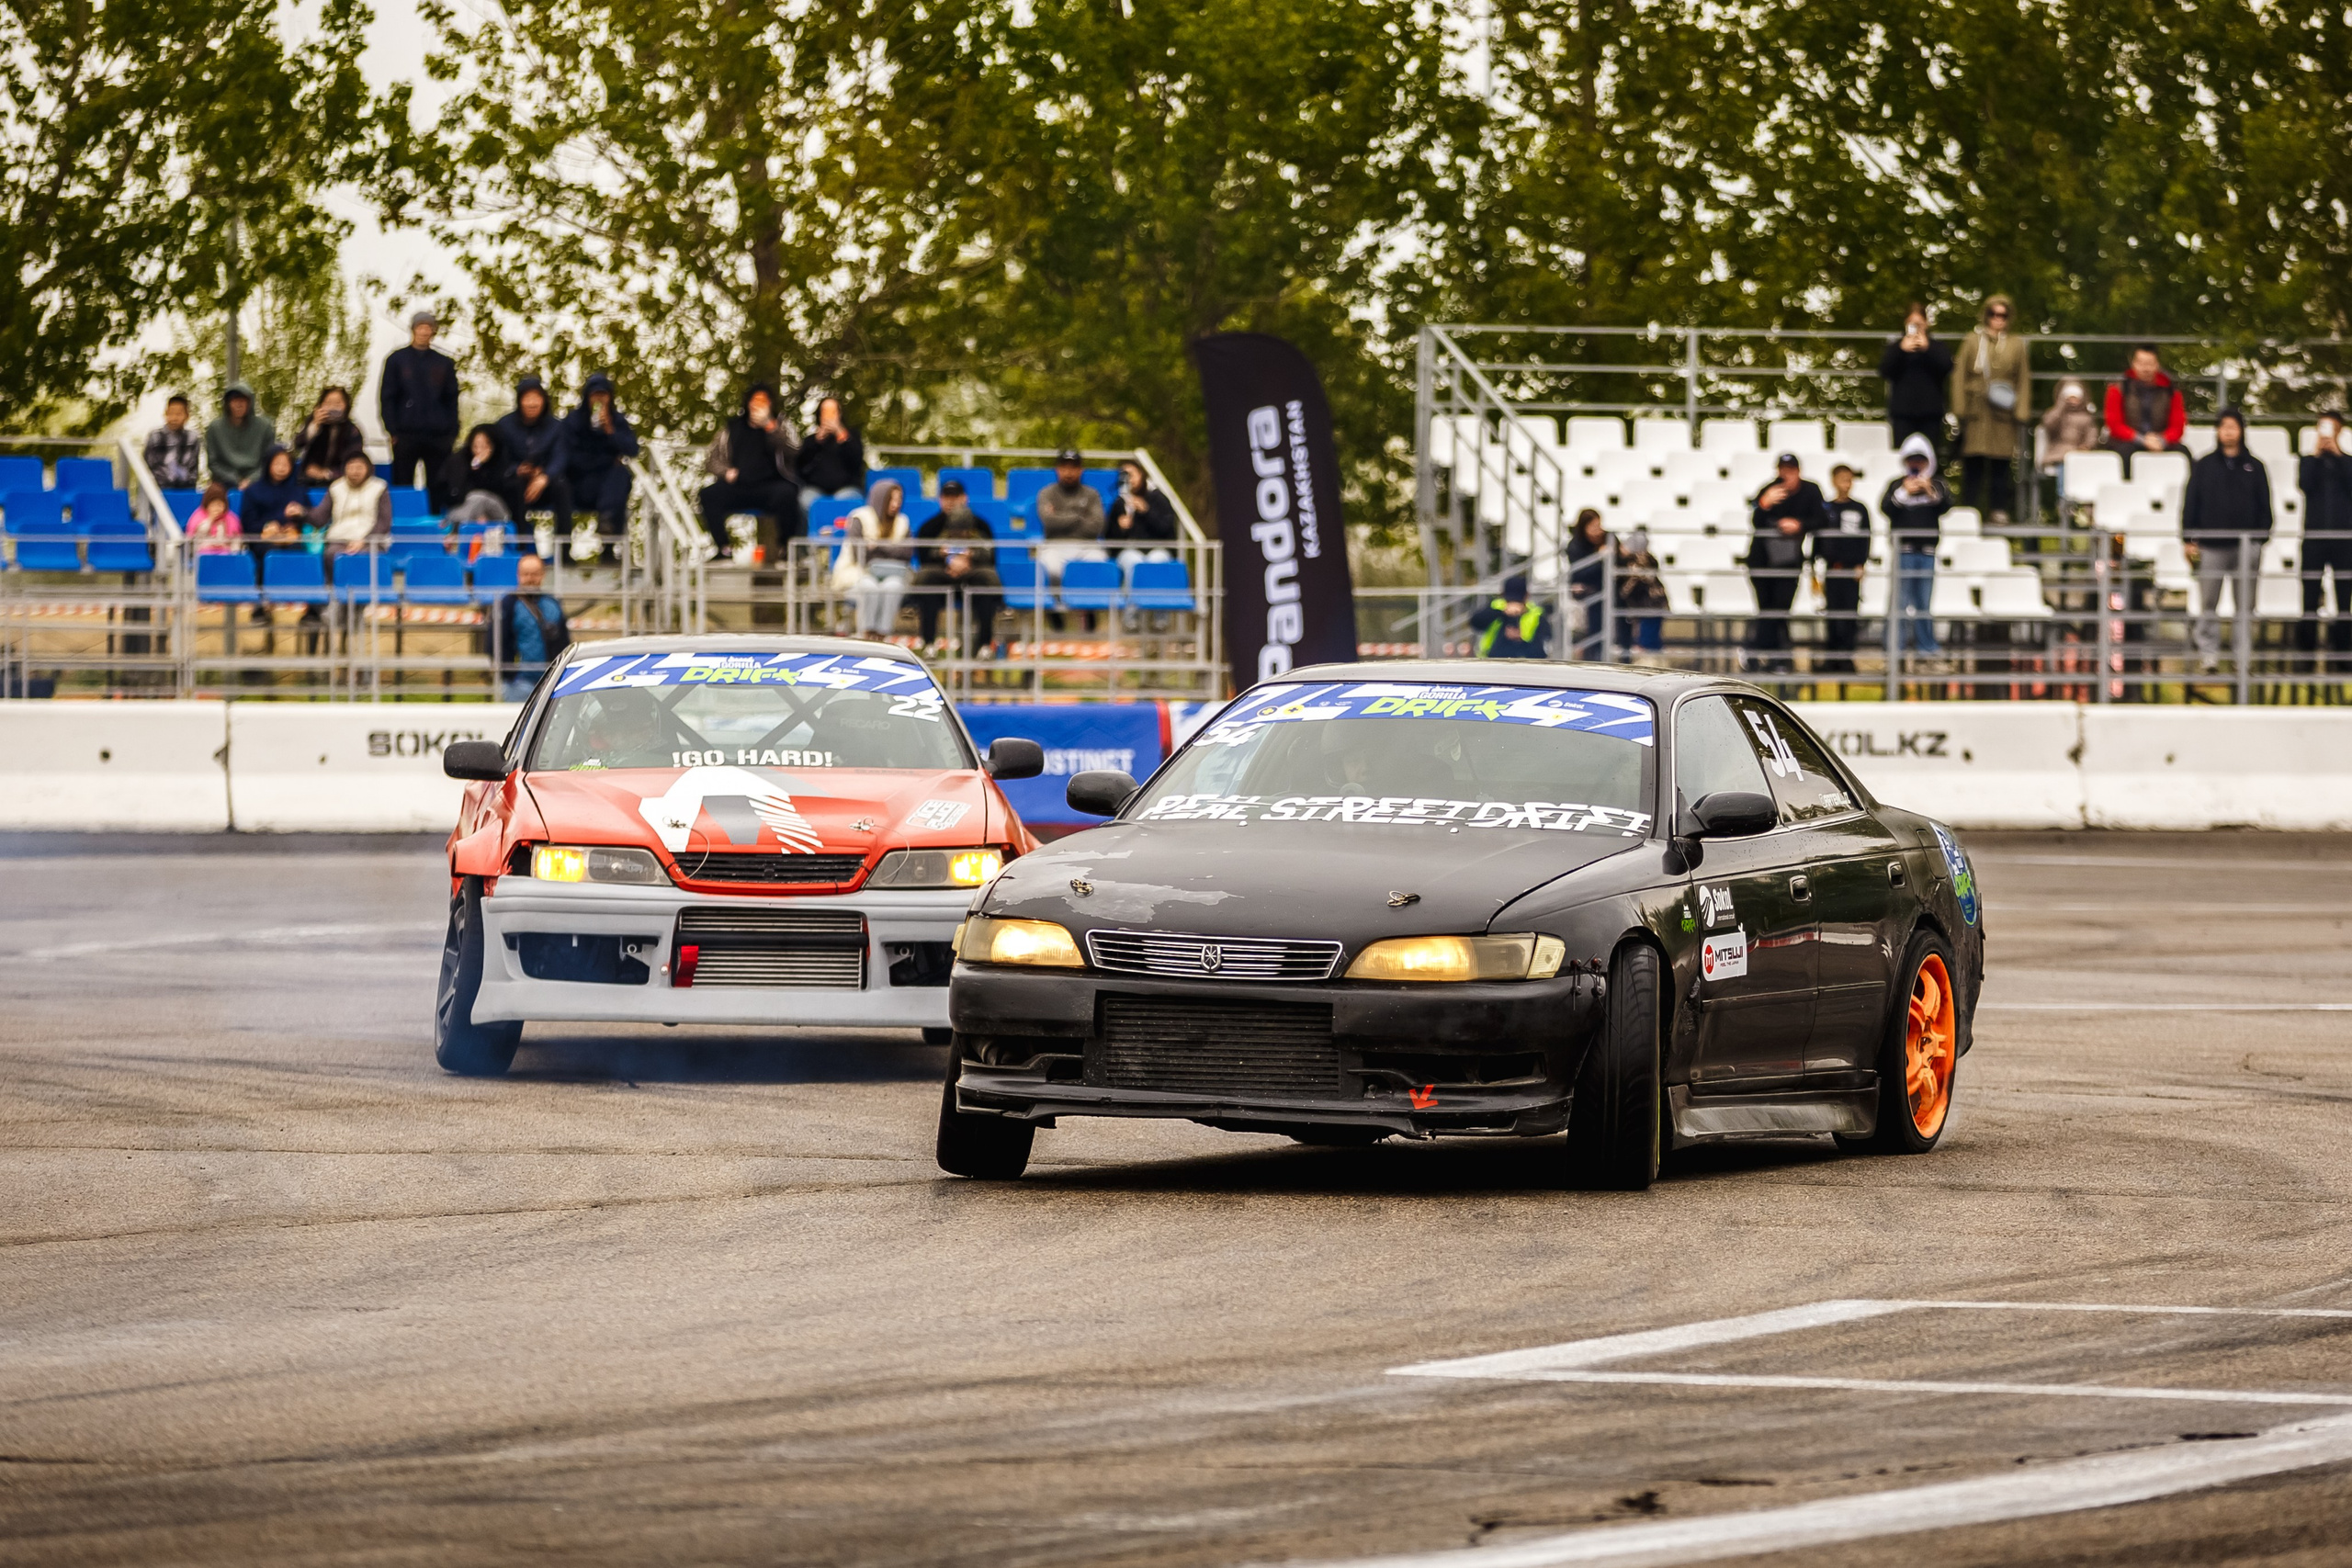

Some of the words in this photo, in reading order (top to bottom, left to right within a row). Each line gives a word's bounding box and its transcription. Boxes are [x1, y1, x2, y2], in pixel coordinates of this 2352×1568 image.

[1286, 400, 1321, 558] KAZAKHSTAN
[679, 667, 802, 686] DRIFT
[720, 660, 762, 669] GORILLA
[1419, 692, 1467, 700] GORILLA
[888, 695, 944, 723] 22
[1360, 696, 1510, 722] DRIFT
[840, 717, 890, 730] RECARO
[1193, 721, 1266, 747] 54
[368, 731, 483, 756] SOK
[1742, 709, 1804, 782] 54
[672, 750, 726, 768] !GO
[737, 749, 833, 768] HARD!
